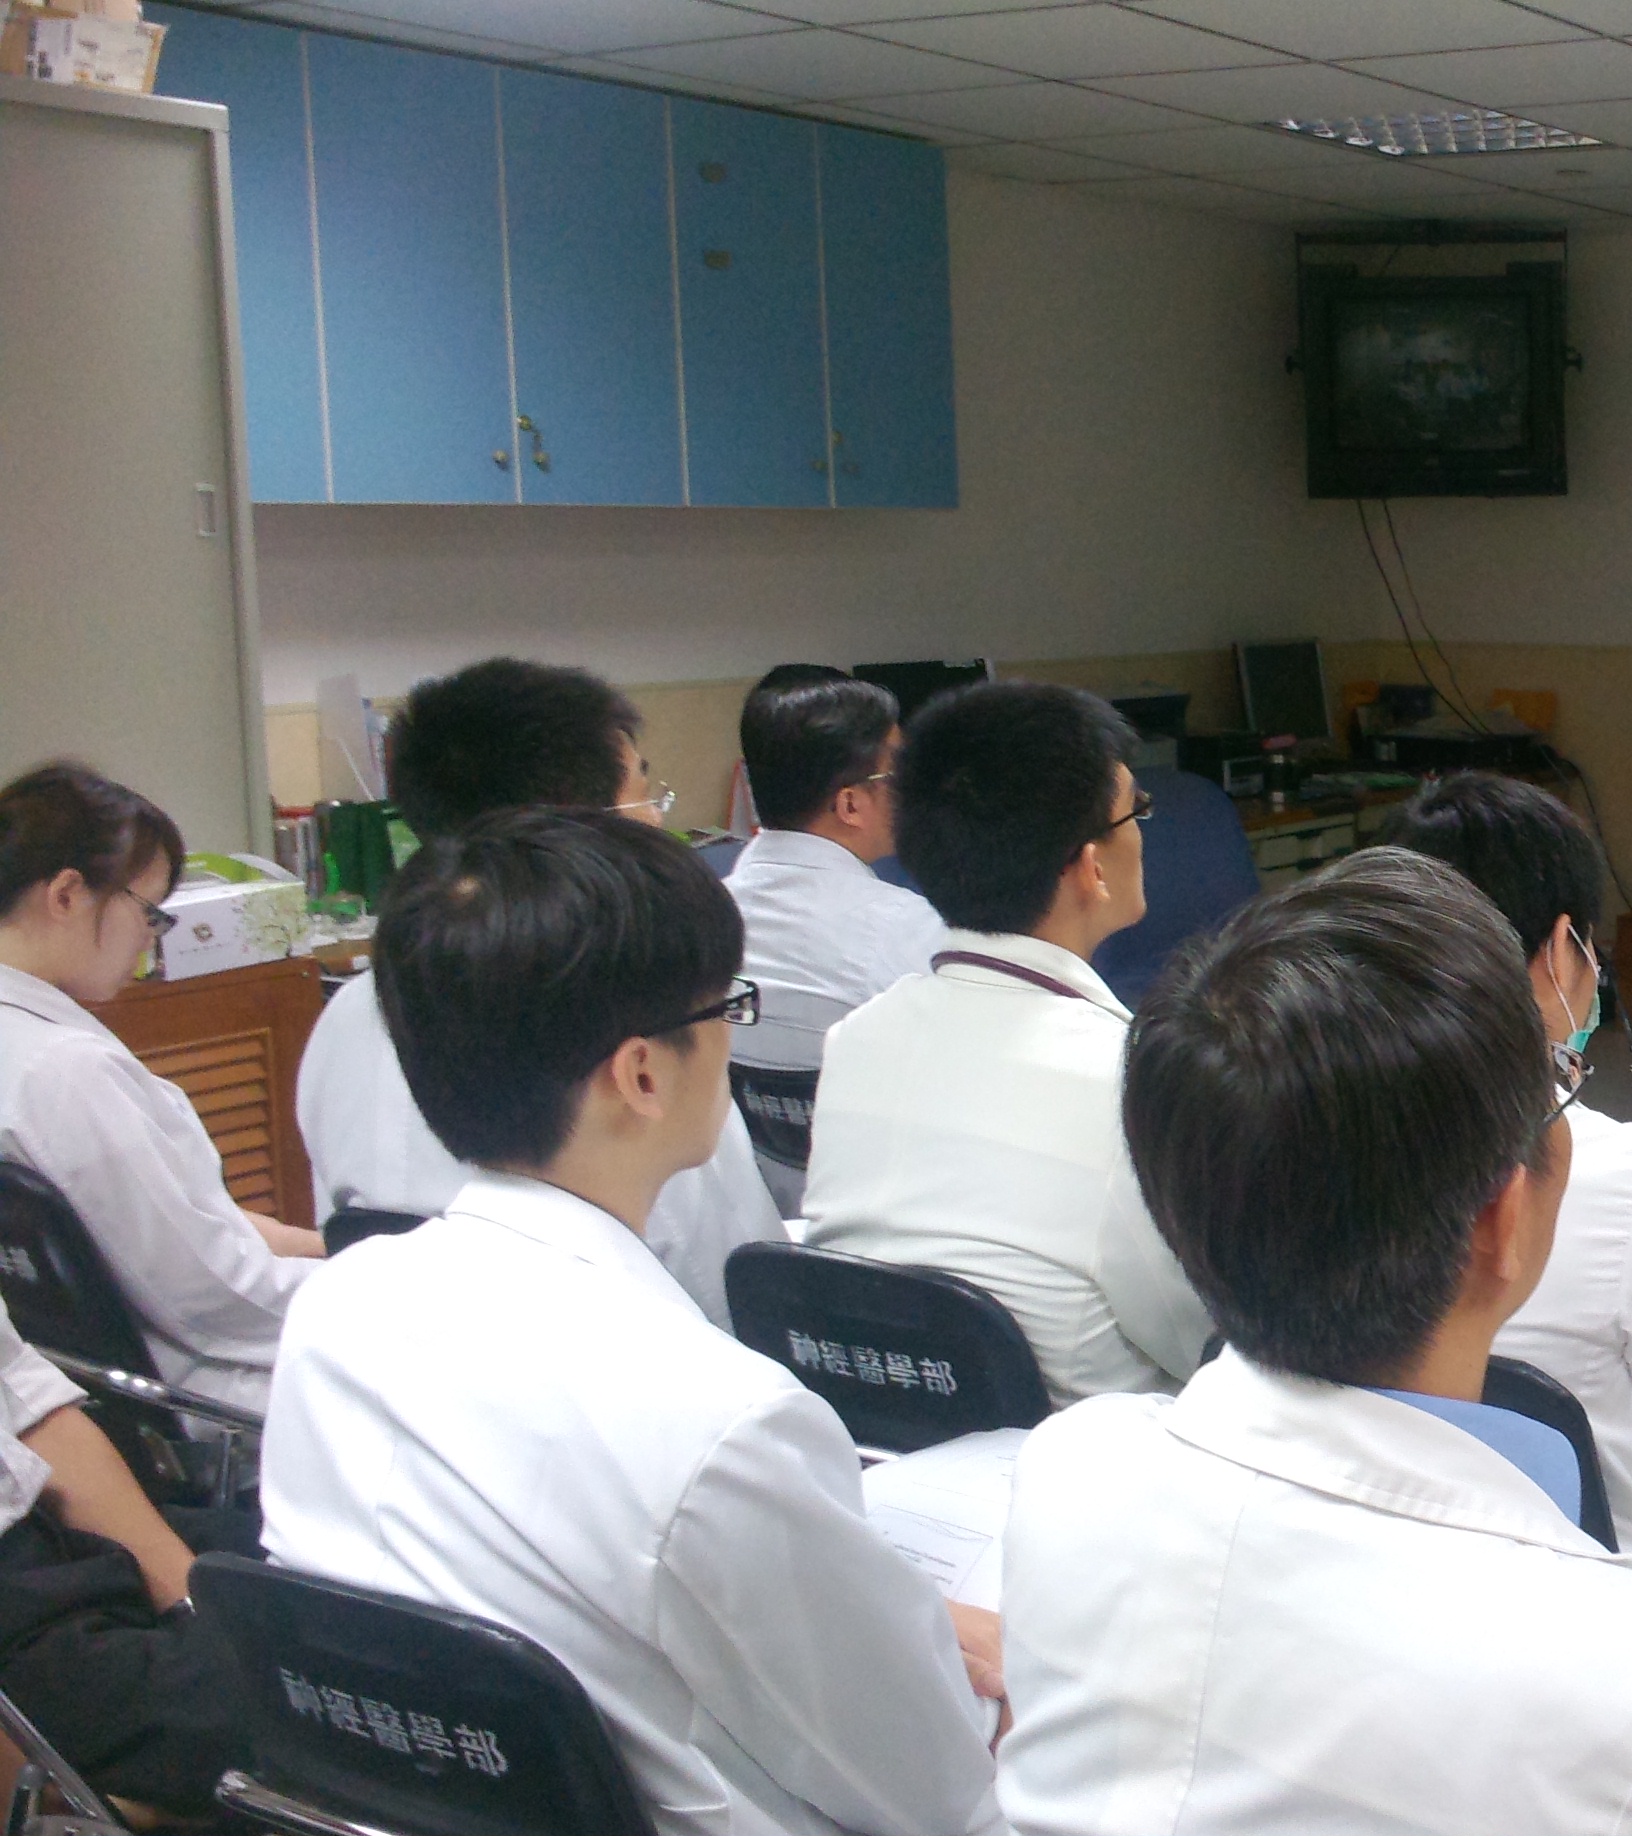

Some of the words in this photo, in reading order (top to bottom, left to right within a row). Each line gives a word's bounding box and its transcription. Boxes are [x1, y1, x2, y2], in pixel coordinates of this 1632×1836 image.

[788, 1329, 957, 1396] 神經醫學部
[279, 1667, 508, 1777] 神經醫學部
